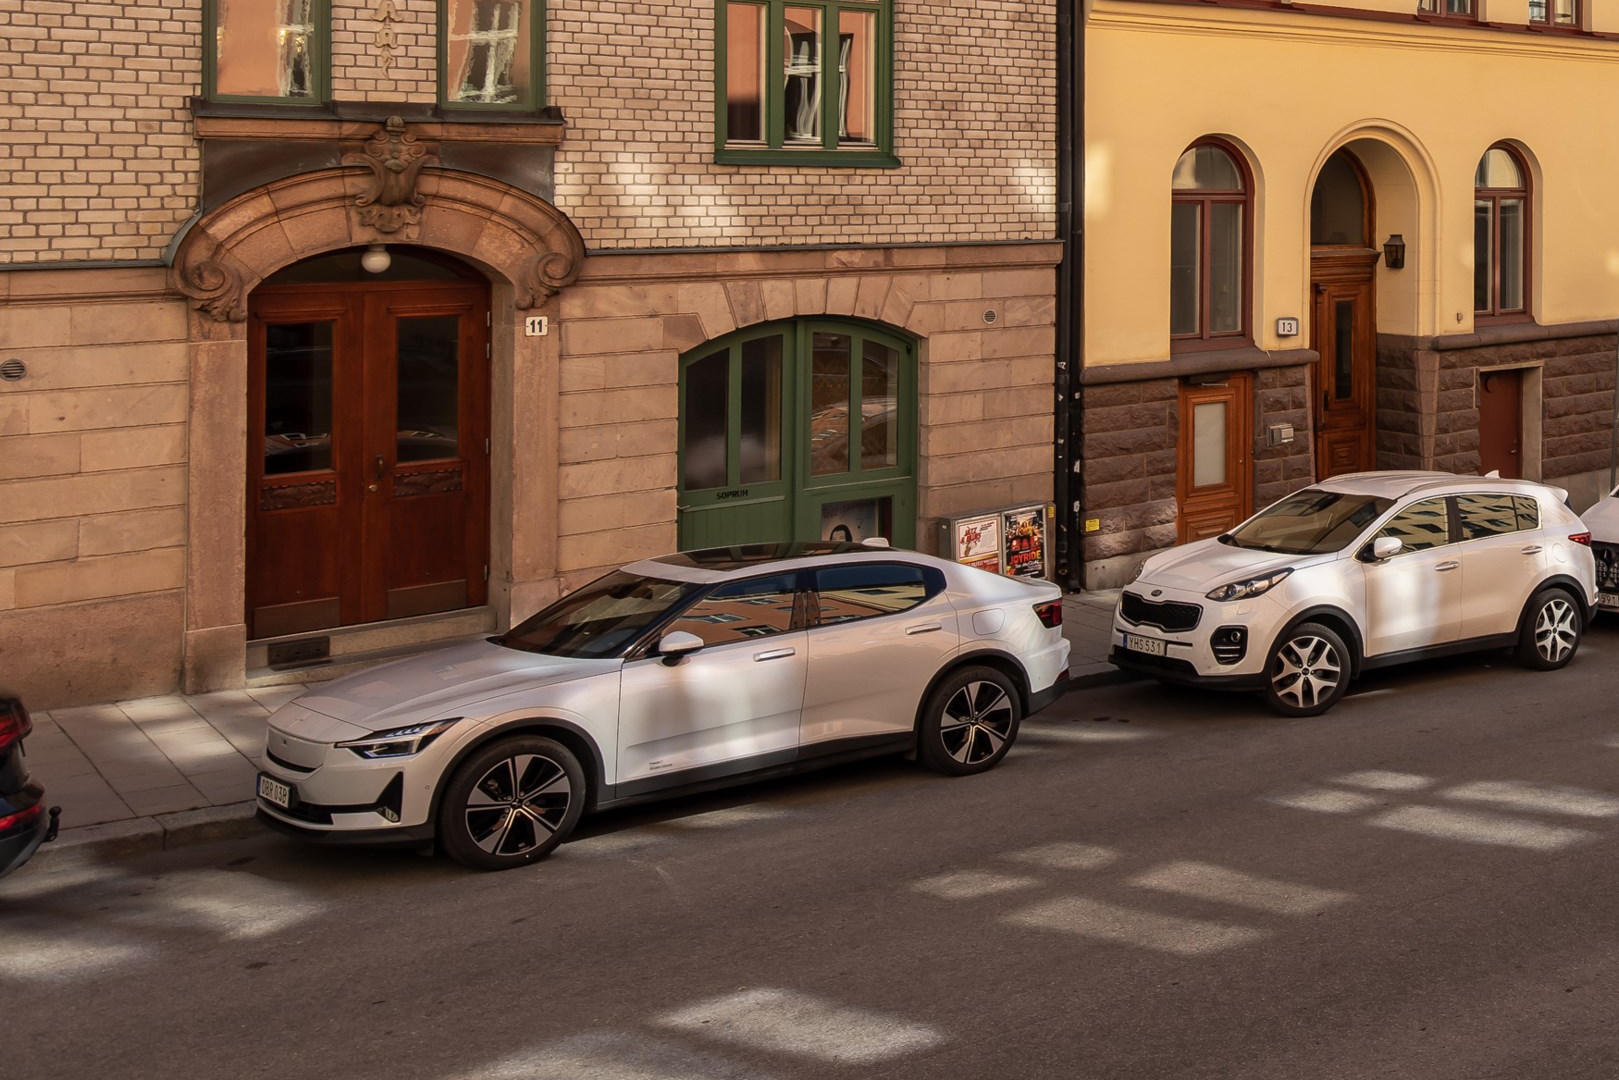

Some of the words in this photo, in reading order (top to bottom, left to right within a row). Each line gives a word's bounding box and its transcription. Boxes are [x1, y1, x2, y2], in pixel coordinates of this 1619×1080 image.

[530, 319, 543, 333] 11
[1282, 322, 1293, 332] 13
[1009, 550, 1042, 566] JOYRIDE
[1129, 638, 1144, 650] YHS
[1145, 640, 1161, 654] 531
